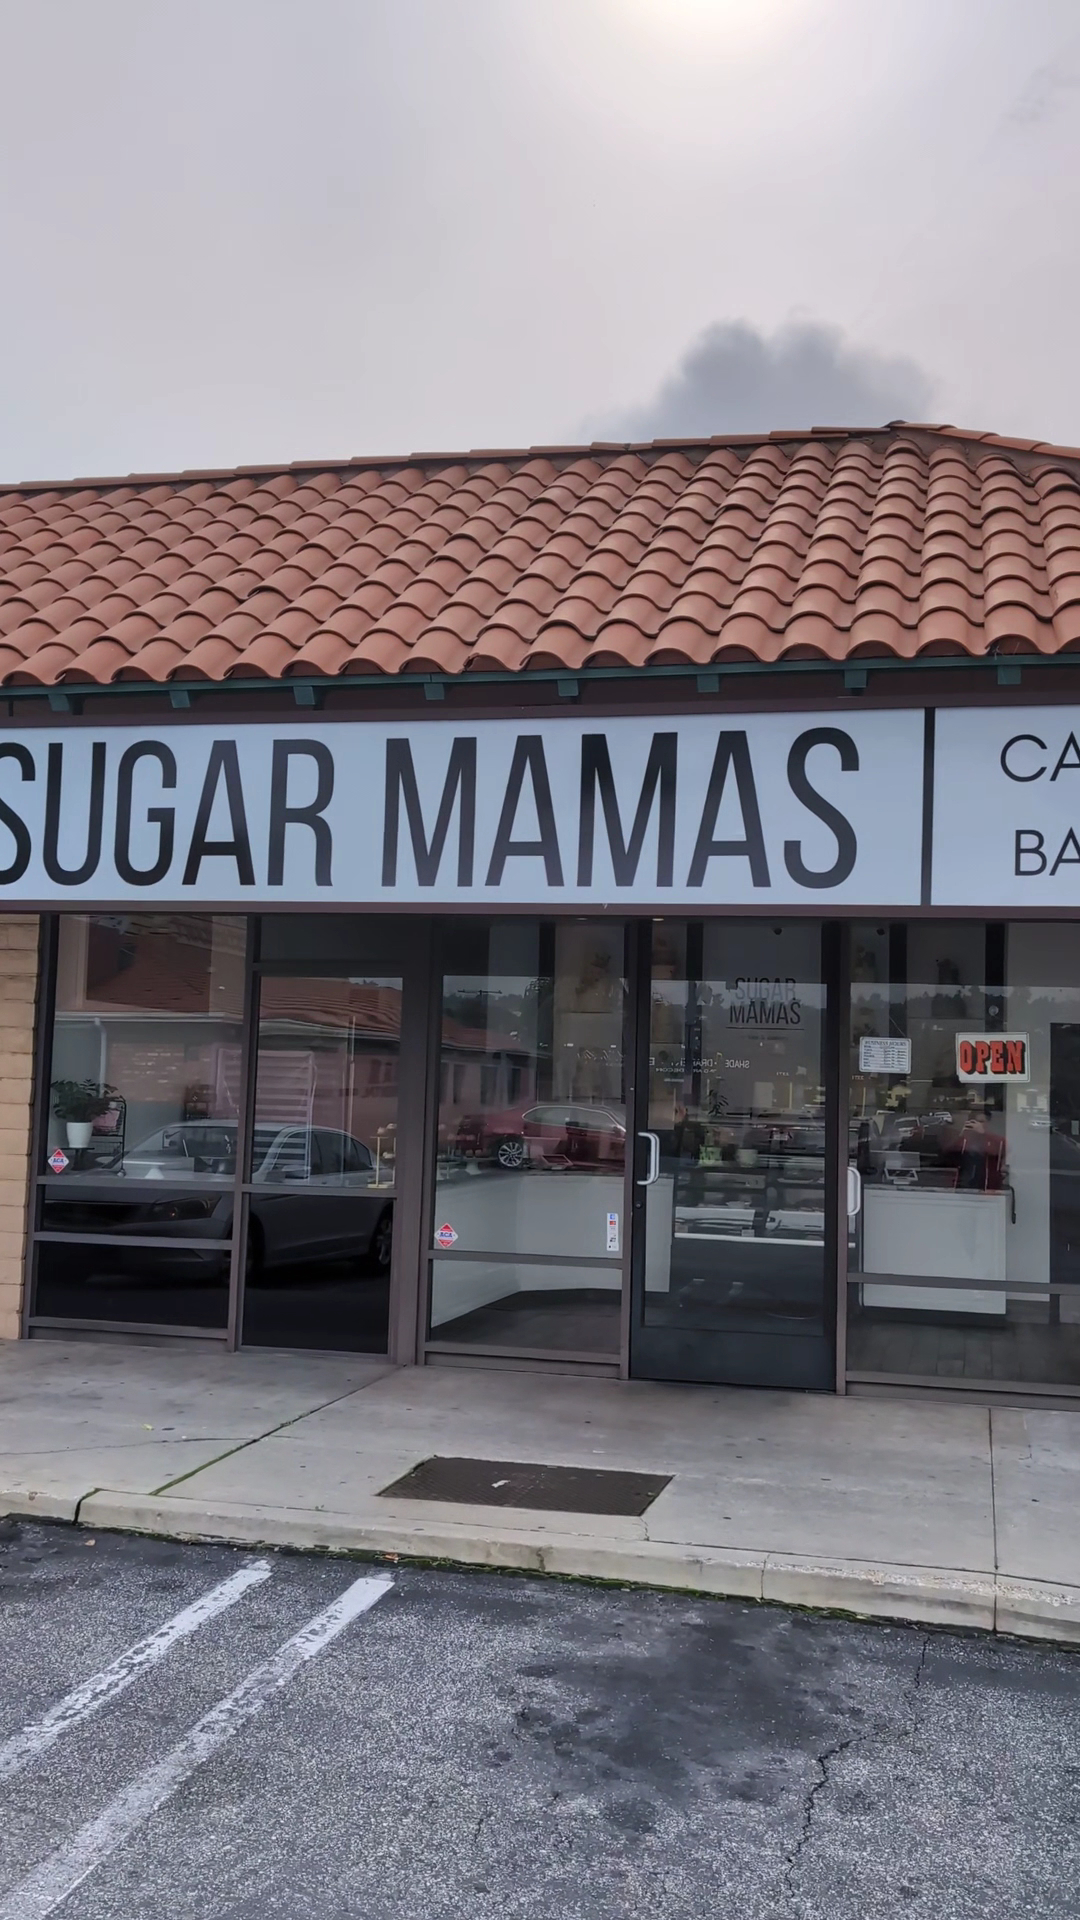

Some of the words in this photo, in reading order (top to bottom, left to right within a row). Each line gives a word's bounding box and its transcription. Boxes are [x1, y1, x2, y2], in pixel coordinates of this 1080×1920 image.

[381, 727, 859, 889] MAMAS
[735, 977, 796, 1000] SUGAR
[730, 1001, 801, 1024] MAMAS
[959, 1040, 1025, 1075] OPEN
